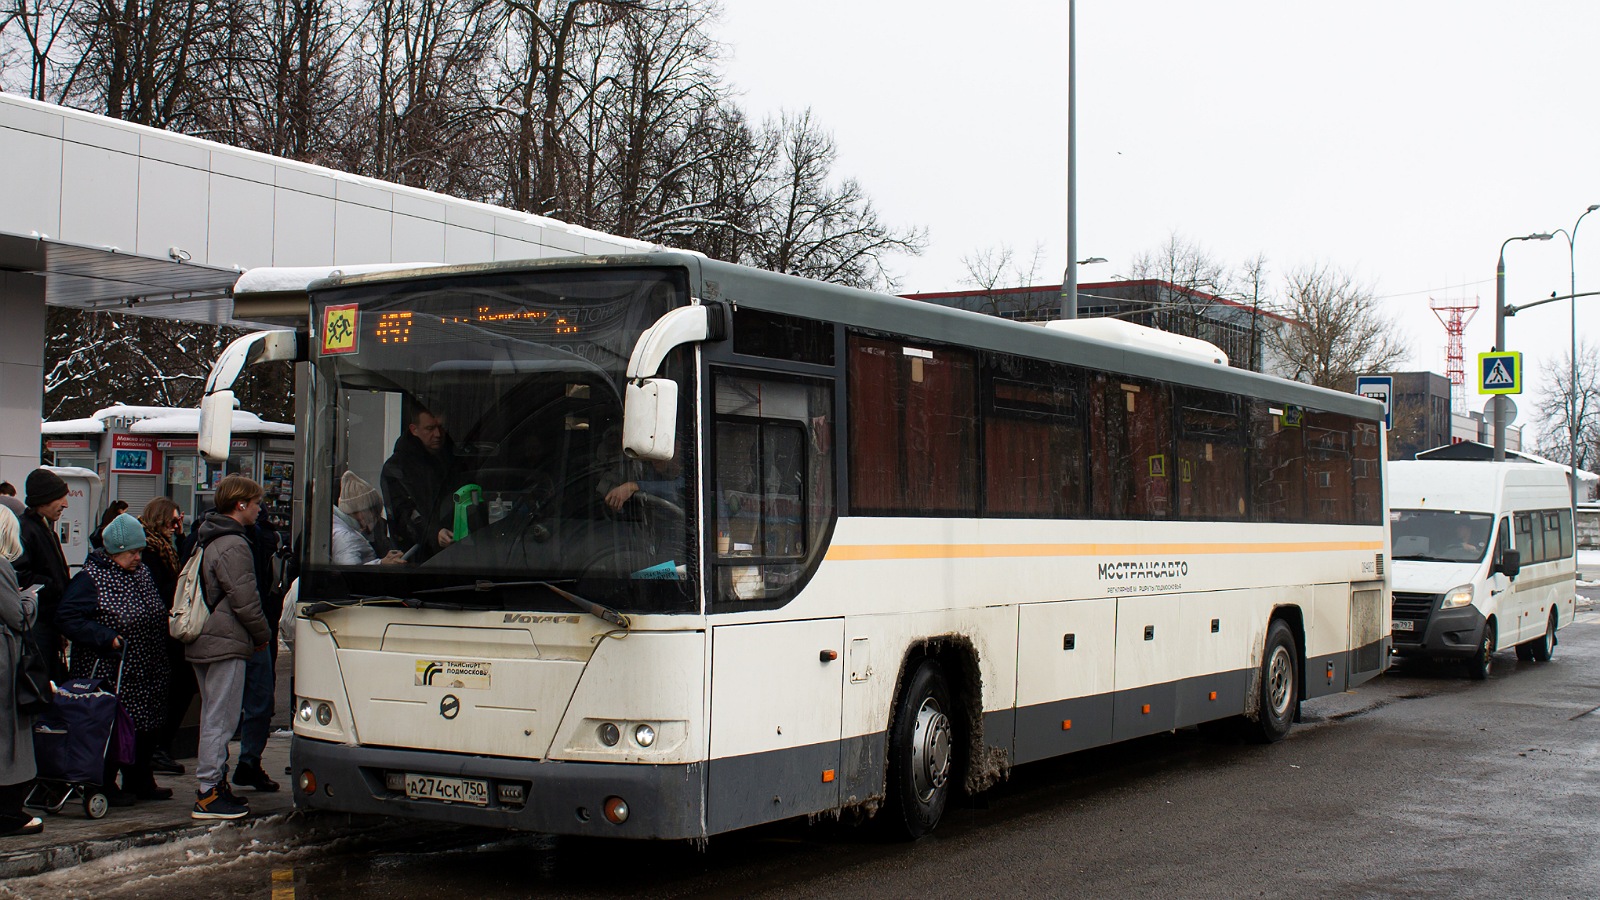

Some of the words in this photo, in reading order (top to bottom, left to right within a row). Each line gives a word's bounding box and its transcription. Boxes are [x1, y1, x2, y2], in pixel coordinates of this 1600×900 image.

[1098, 561, 1188, 580] МОСТРАНСАВТО
[410, 778, 461, 798] А274СК
[463, 781, 484, 796] 750
